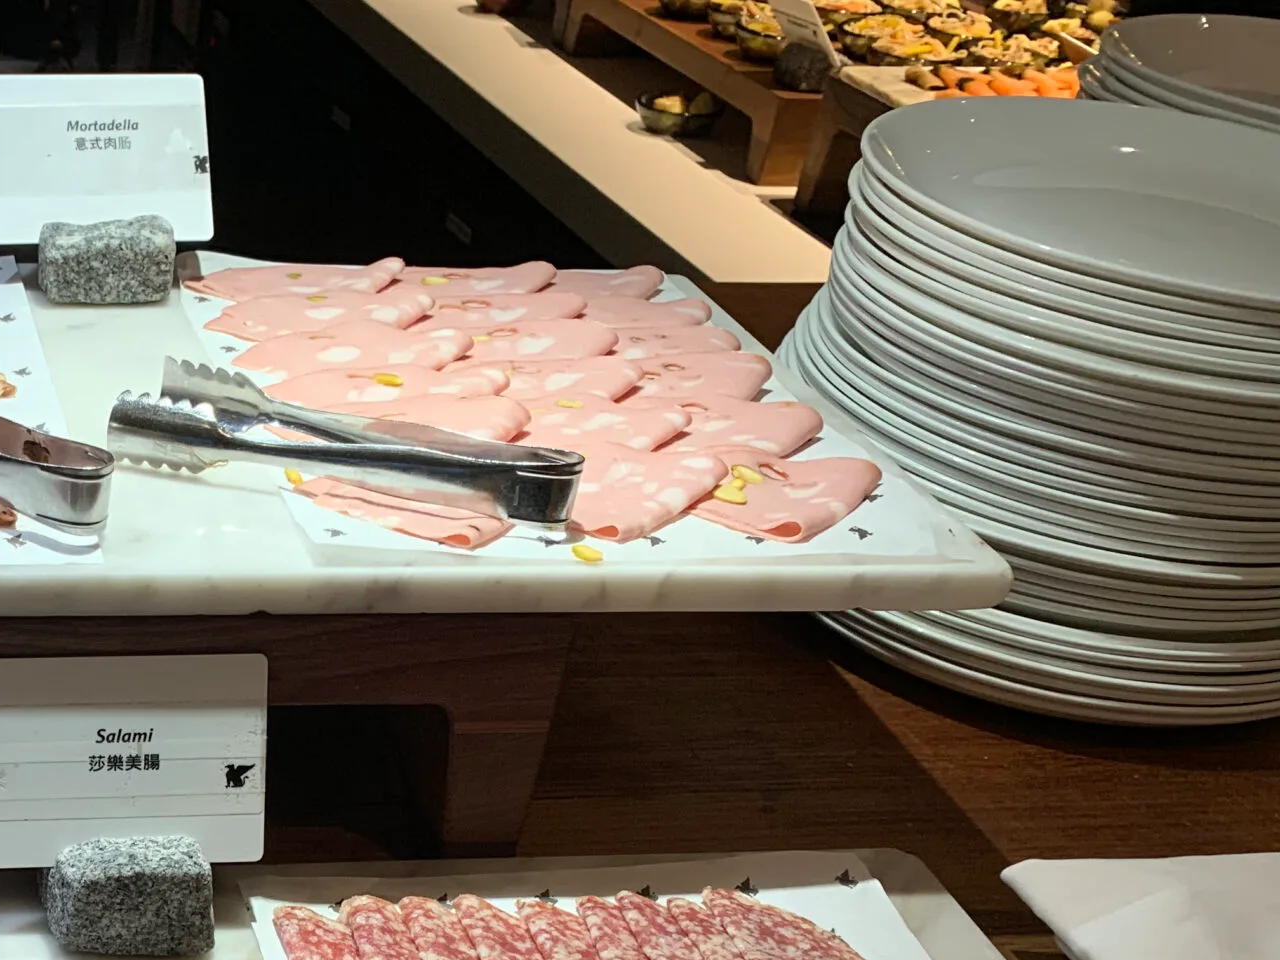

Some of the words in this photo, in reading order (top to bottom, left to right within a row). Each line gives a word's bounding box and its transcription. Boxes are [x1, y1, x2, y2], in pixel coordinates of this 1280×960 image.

[66, 119, 139, 132] Mortadella
[95, 728, 154, 744] Salami
[88, 753, 161, 772] 莎樂美腸
